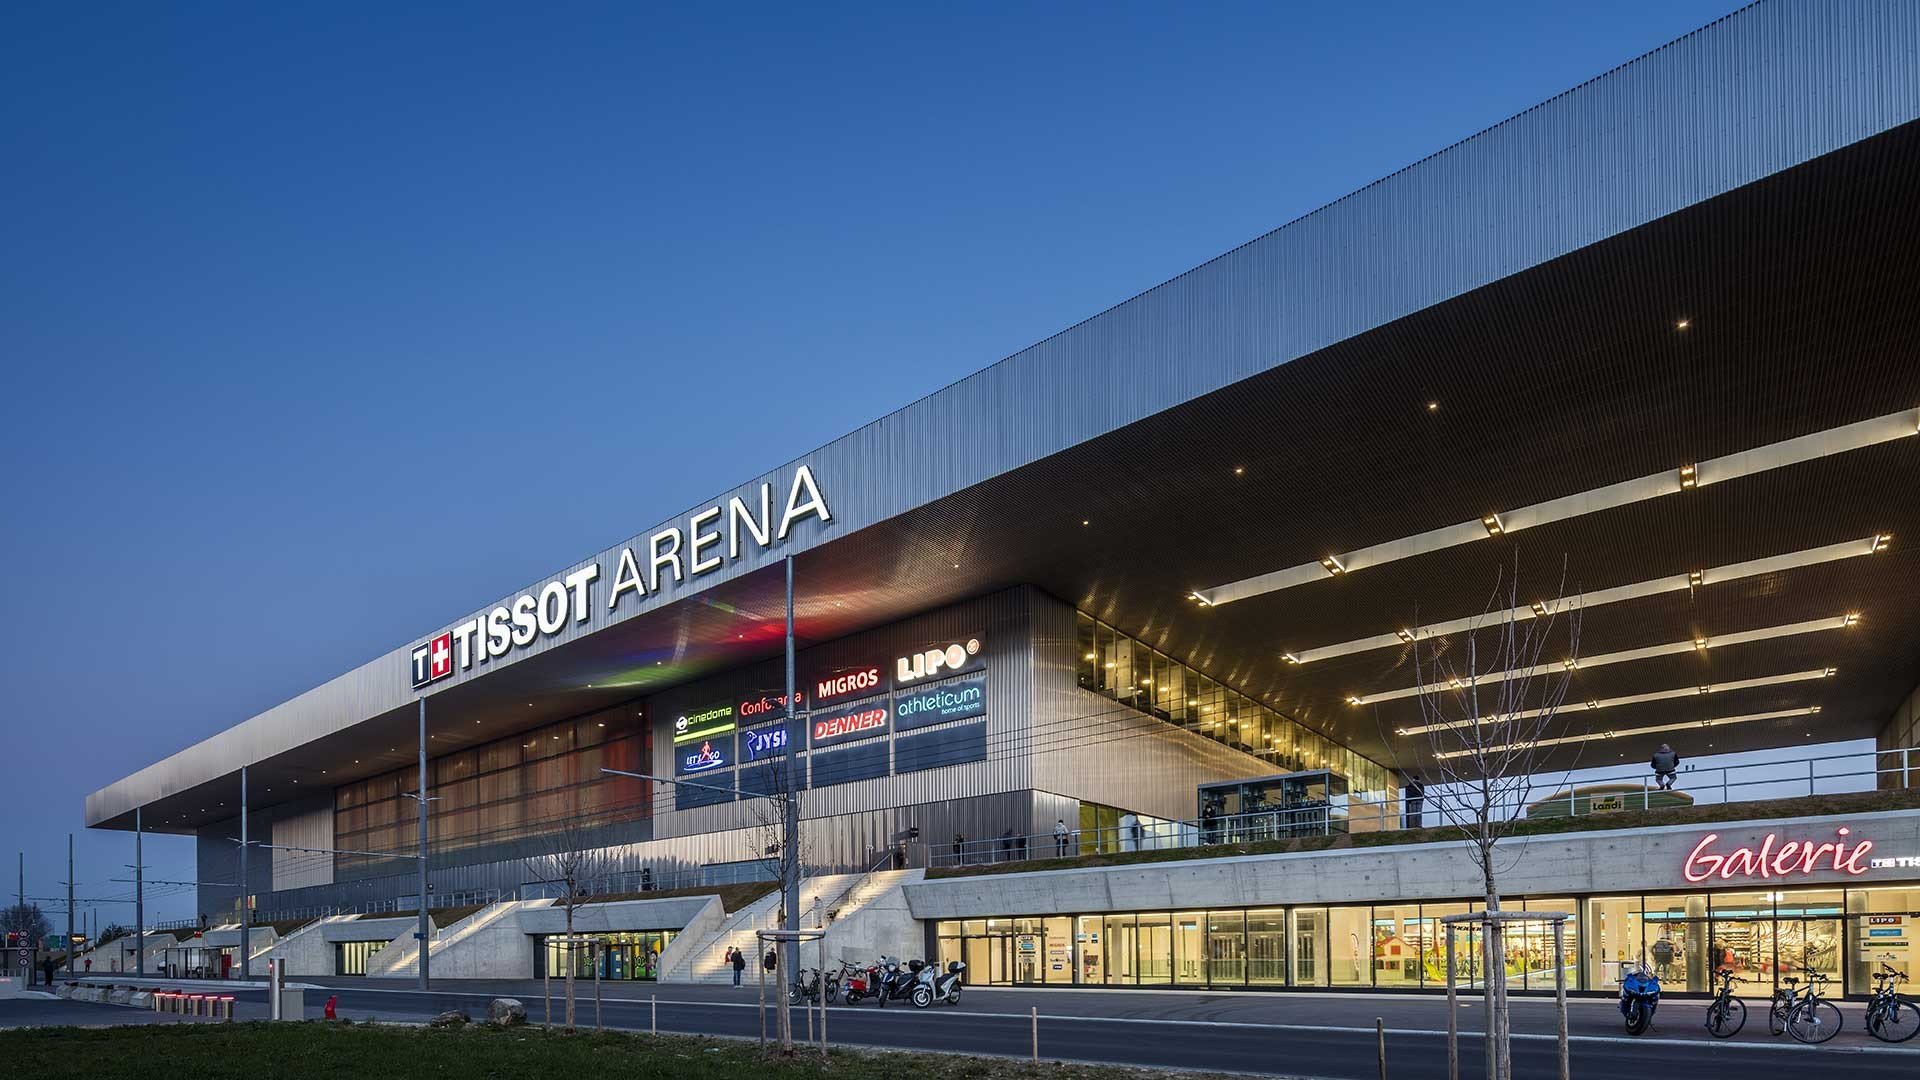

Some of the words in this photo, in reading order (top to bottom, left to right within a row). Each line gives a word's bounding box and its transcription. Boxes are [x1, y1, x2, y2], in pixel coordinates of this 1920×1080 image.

[453, 563, 600, 669] TISSOT
[608, 464, 832, 610] ARENA
[897, 643, 967, 682] LIPO
[818, 669, 879, 698] MIGROS
[687, 706, 732, 725] cinedome
[898, 687, 980, 717] athleticum
[814, 708, 887, 740] DENNER
[1593, 800, 1622, 811] Landi
[1684, 827, 1873, 882] Galerie
